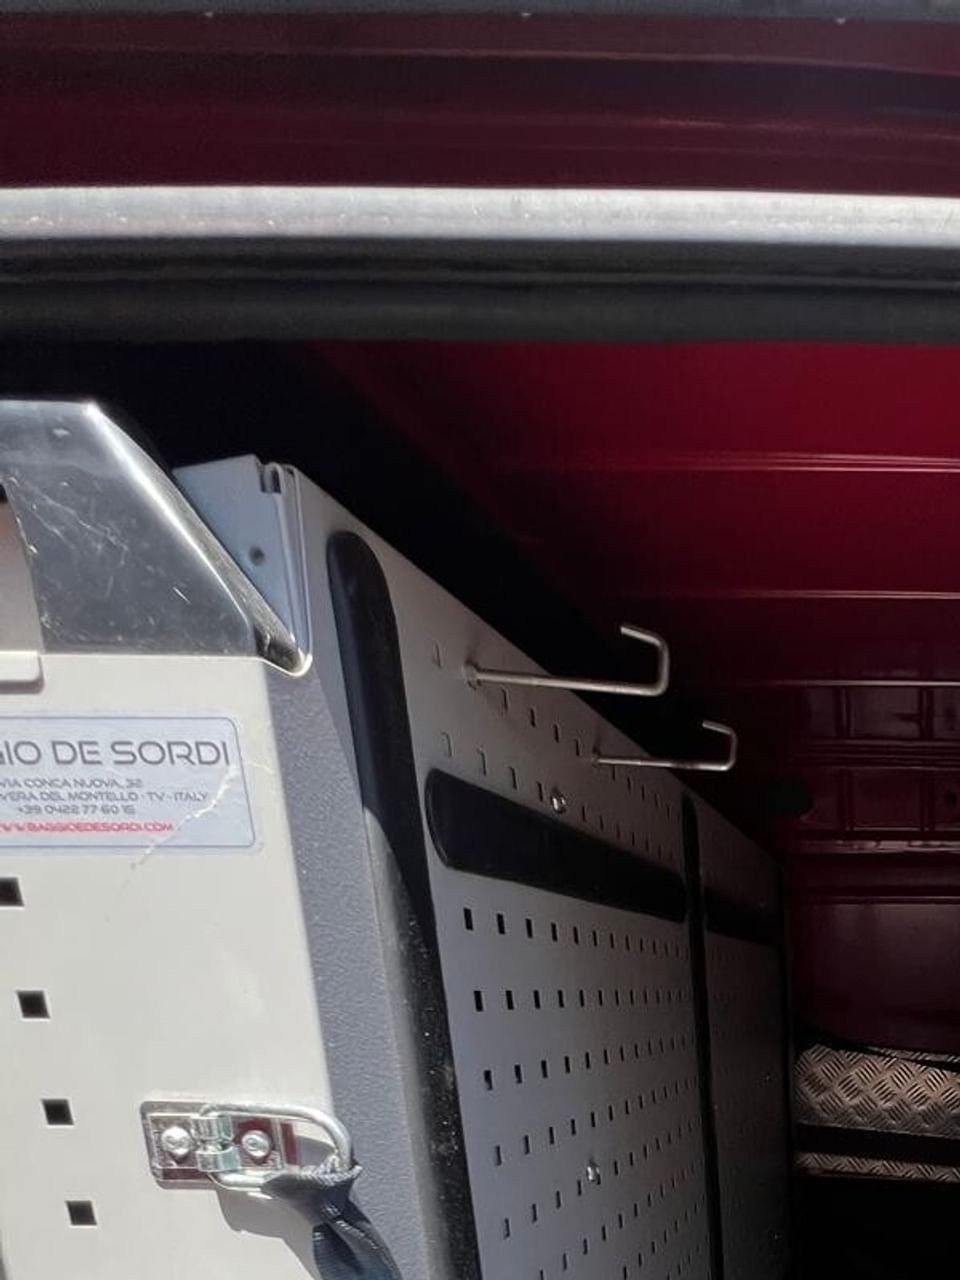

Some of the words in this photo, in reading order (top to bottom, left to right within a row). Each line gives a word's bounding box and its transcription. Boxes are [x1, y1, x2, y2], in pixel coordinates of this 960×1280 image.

[51, 740, 103, 766] DE
[110, 740, 230, 766] SORDI
[23, 778, 72, 789] CONCA
[40, 791, 66, 801] DEL
[67, 791, 139, 801] MONTELLO
[147, 791, 166, 801] TV
[174, 791, 209, 801] ITALY
[43, 804, 81, 815] 0422
[81, 804, 98, 815] 77
